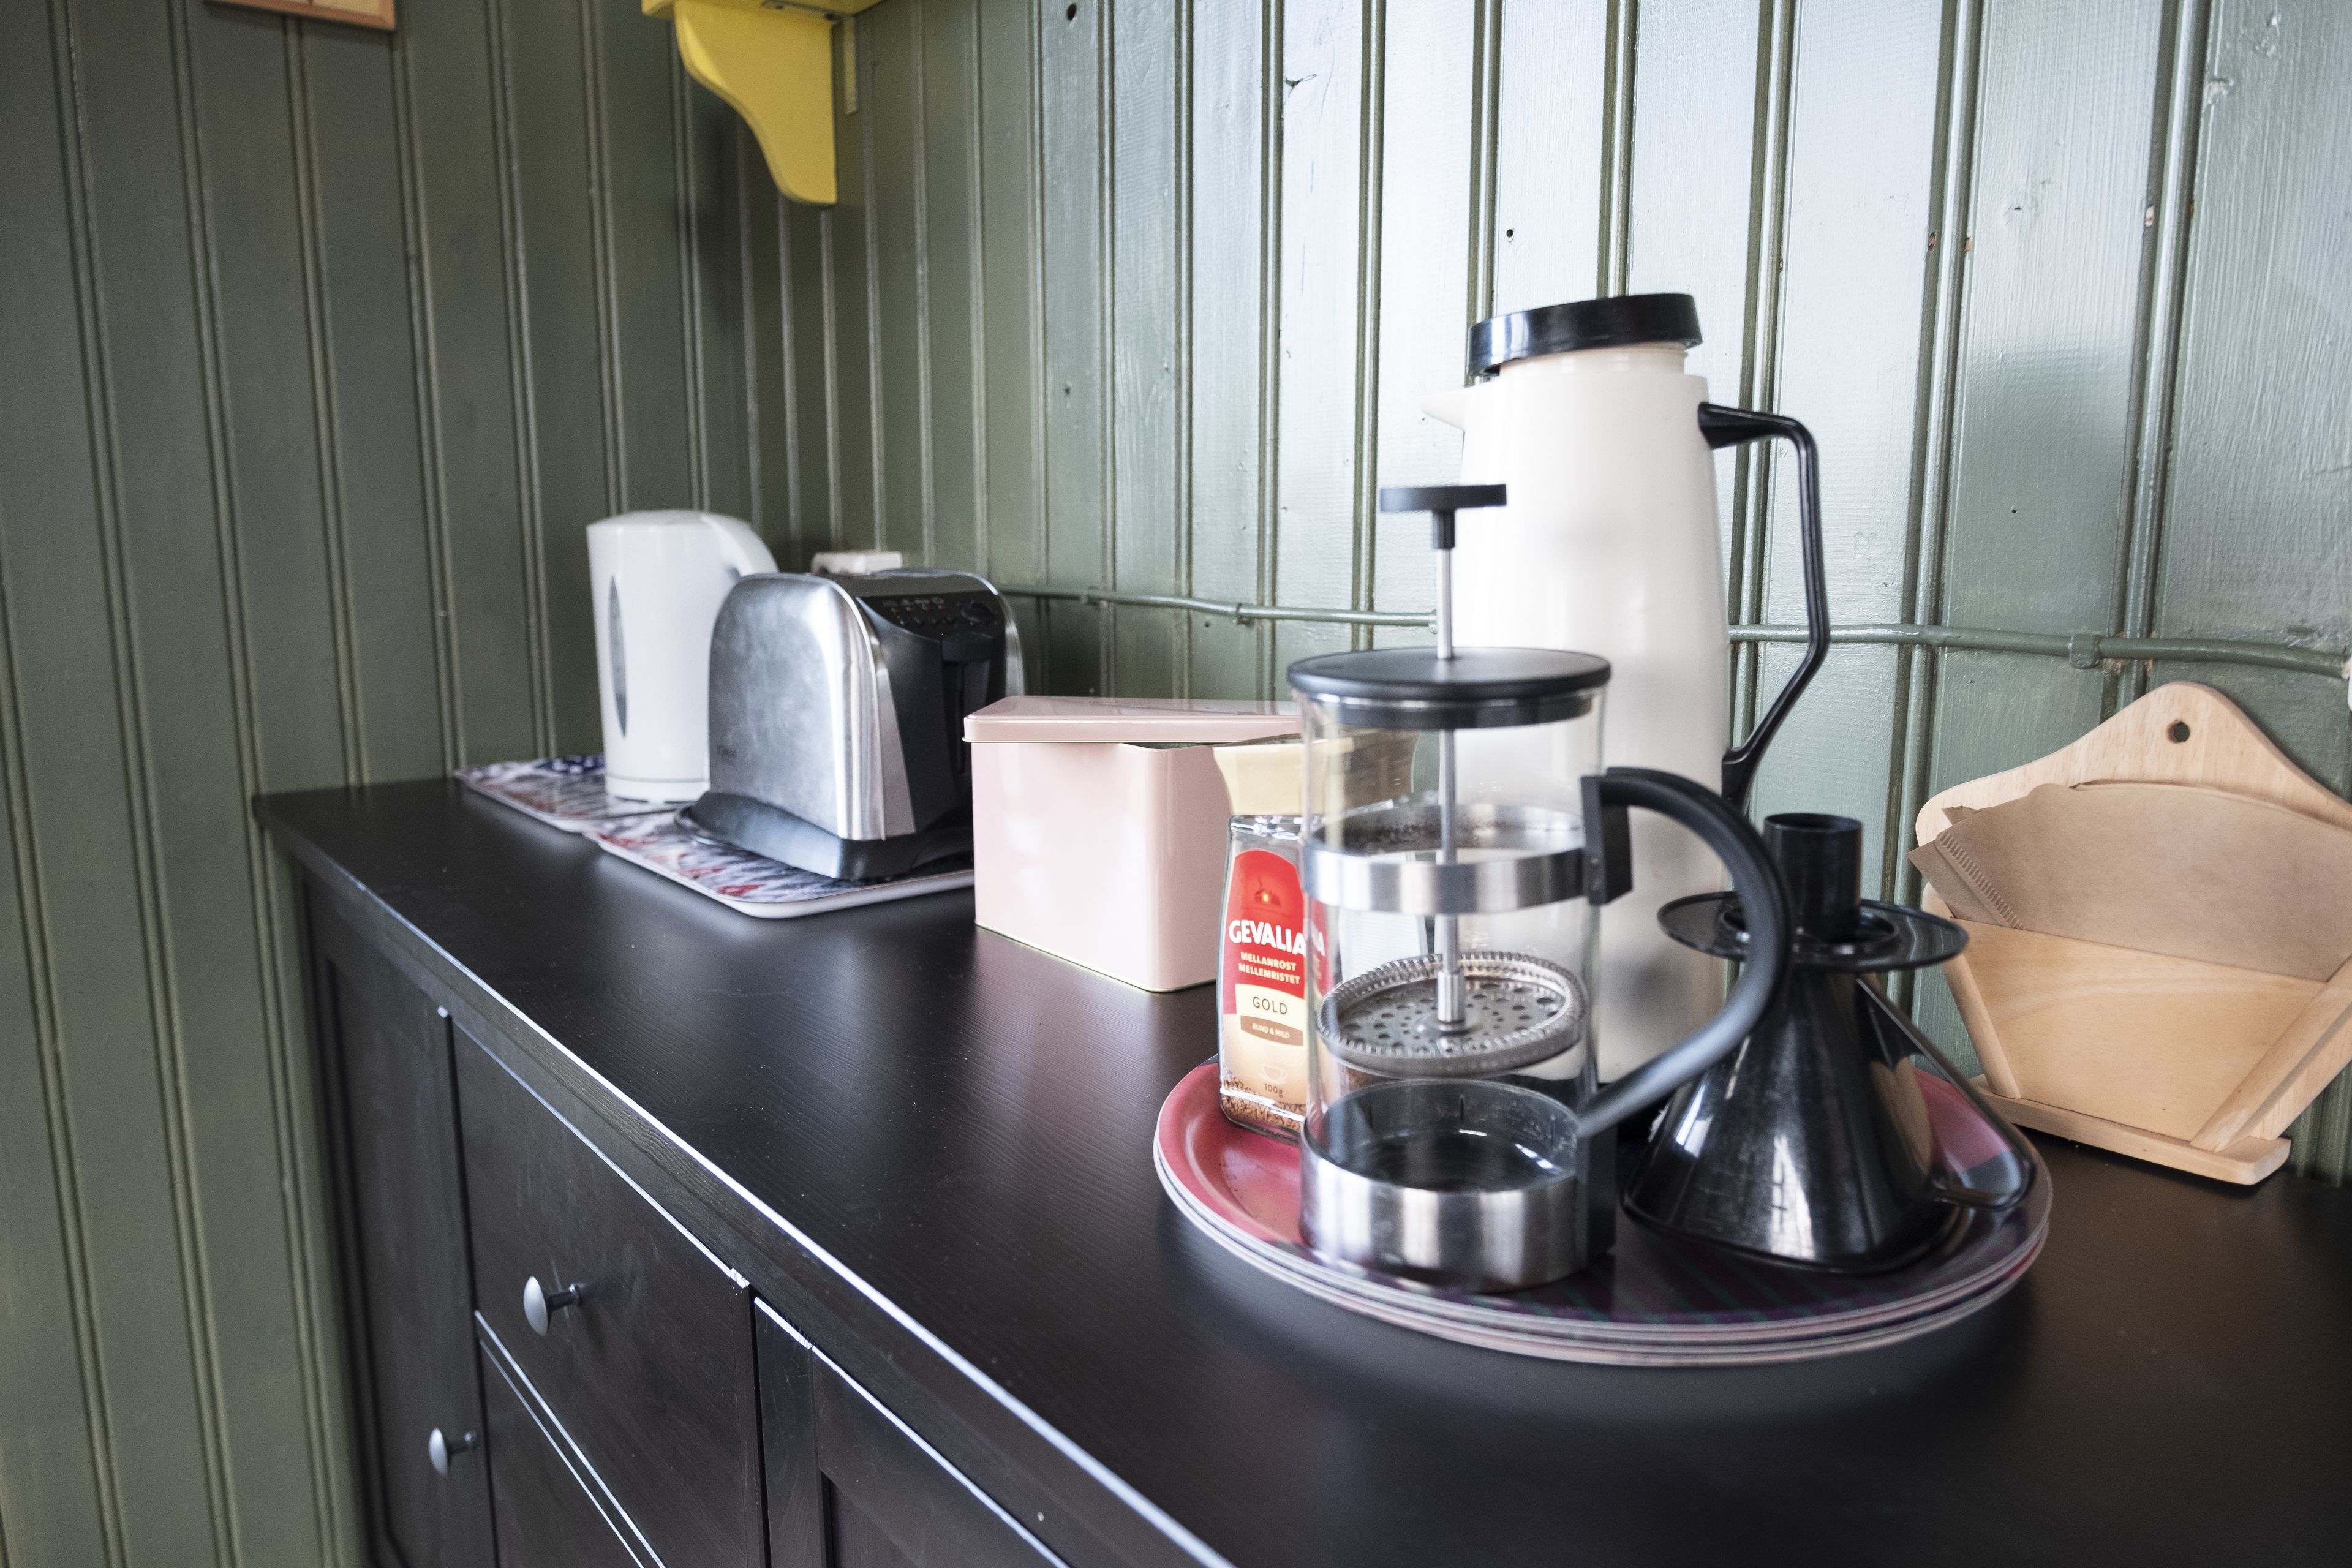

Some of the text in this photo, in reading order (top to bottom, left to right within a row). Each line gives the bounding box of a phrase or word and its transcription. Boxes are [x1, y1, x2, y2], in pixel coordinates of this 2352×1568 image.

[1229, 919, 1306, 957] GEVALIA
[1240, 952, 1297, 971] MELLANROST
[1238, 963, 1300, 985] MELLEMRISTET
[1253, 996, 1287, 1014] GOLD
[1252, 1023, 1269, 1033] RUND
[1264, 1083, 1283, 1098] 100g
